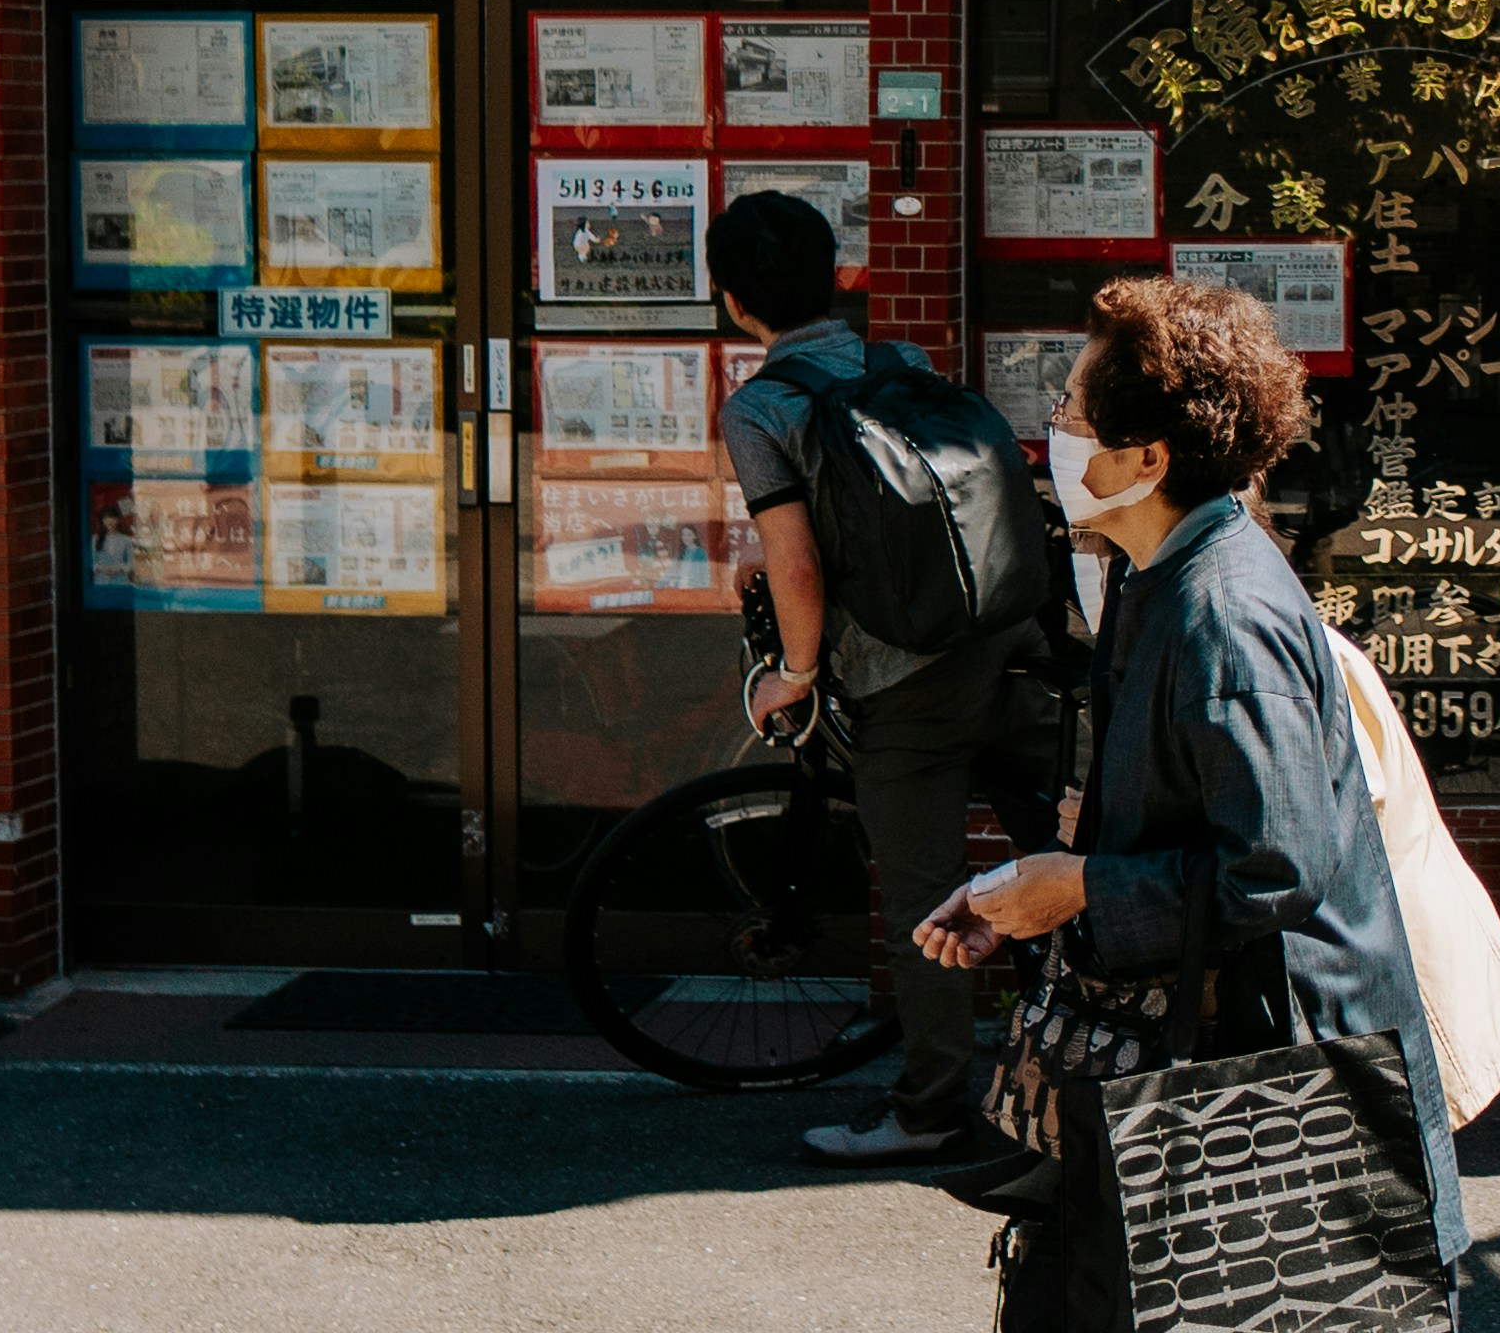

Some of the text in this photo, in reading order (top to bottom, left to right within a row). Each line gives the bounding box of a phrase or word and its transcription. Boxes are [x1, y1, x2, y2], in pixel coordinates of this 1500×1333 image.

[887, 94, 930, 114] 2-1
[230, 294, 381, 331] 特選物件
